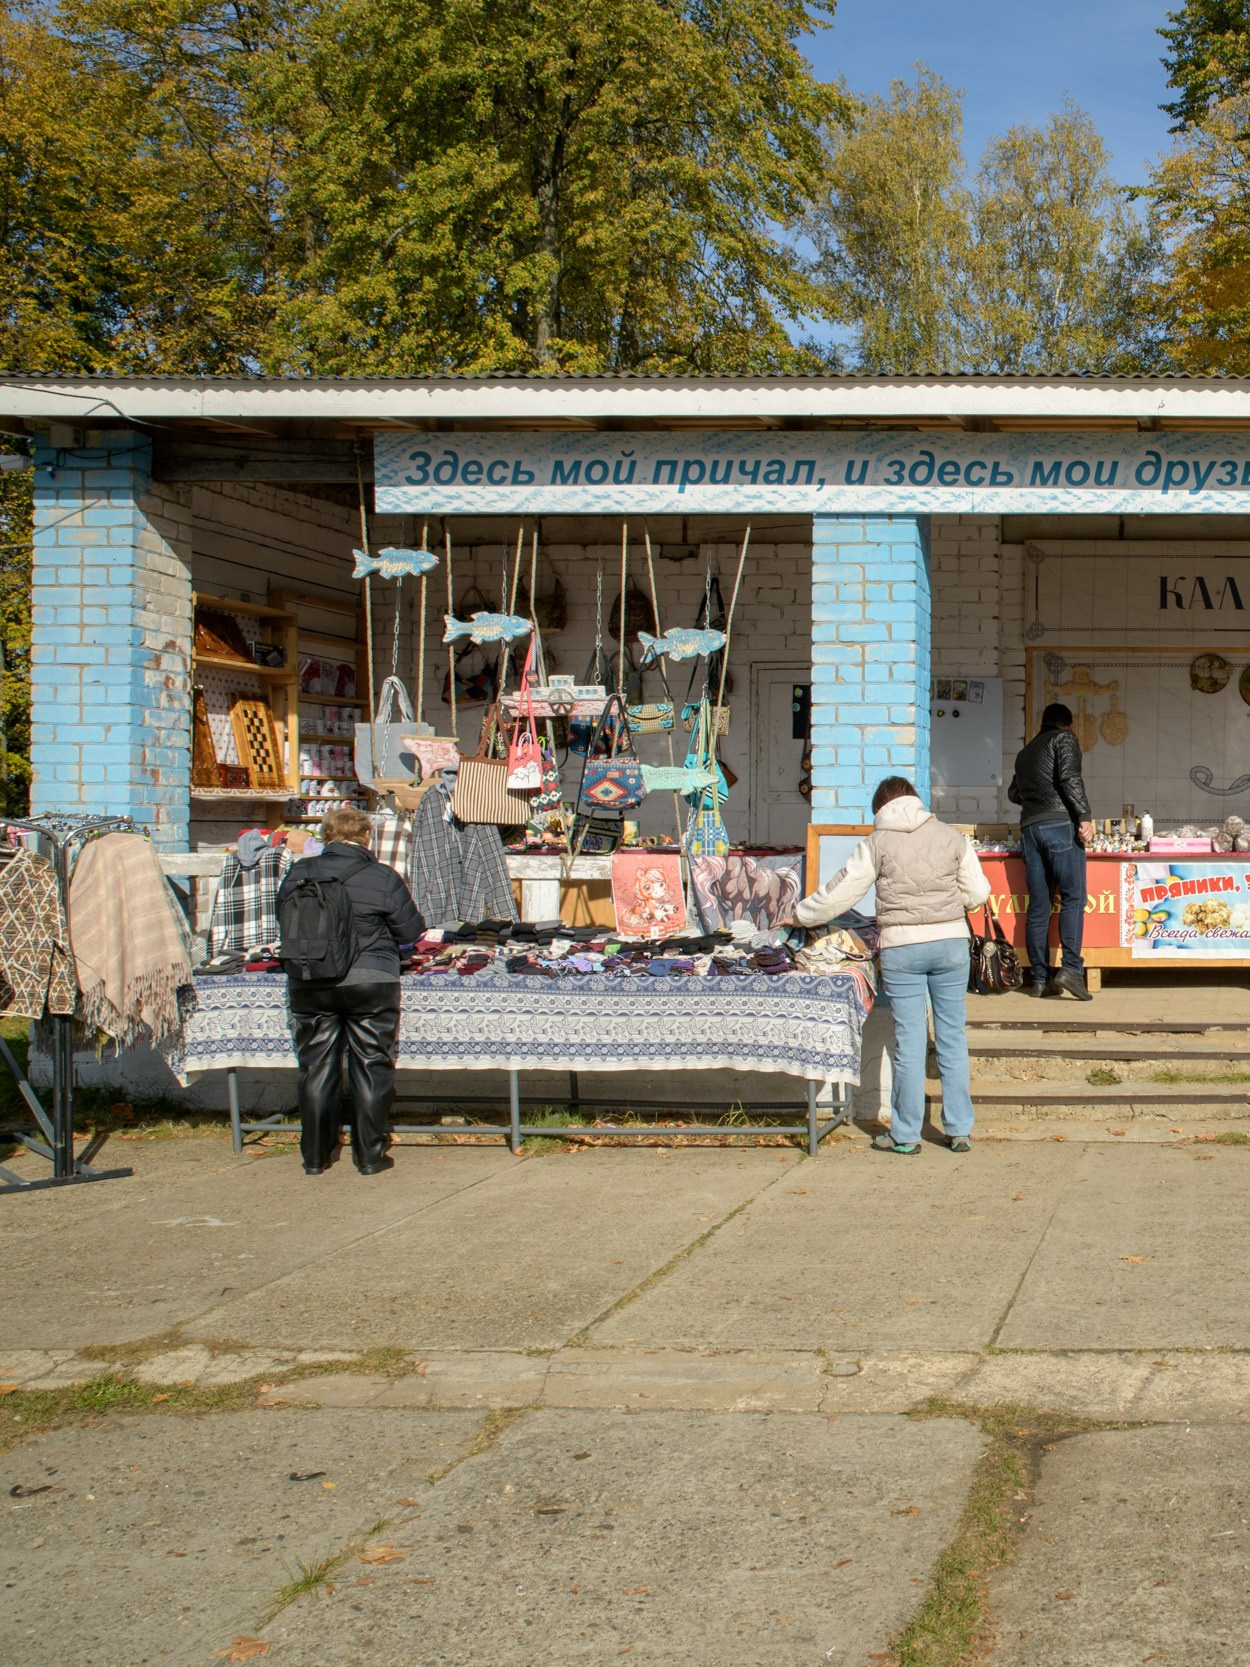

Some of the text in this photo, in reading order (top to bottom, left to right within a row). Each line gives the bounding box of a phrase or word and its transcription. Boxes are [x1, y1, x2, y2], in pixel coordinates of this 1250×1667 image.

[404, 450, 536, 486] Здесь
[550, 450, 638, 486] мой
[651, 459, 826, 494] причал,
[844, 459, 870, 486] и
[883, 450, 1014, 487] здесь
[1029, 459, 1119, 487] мои
[1140, 875, 1241, 903] ПРЯНИКИ,
[1149, 924, 1198, 943] Всегда
